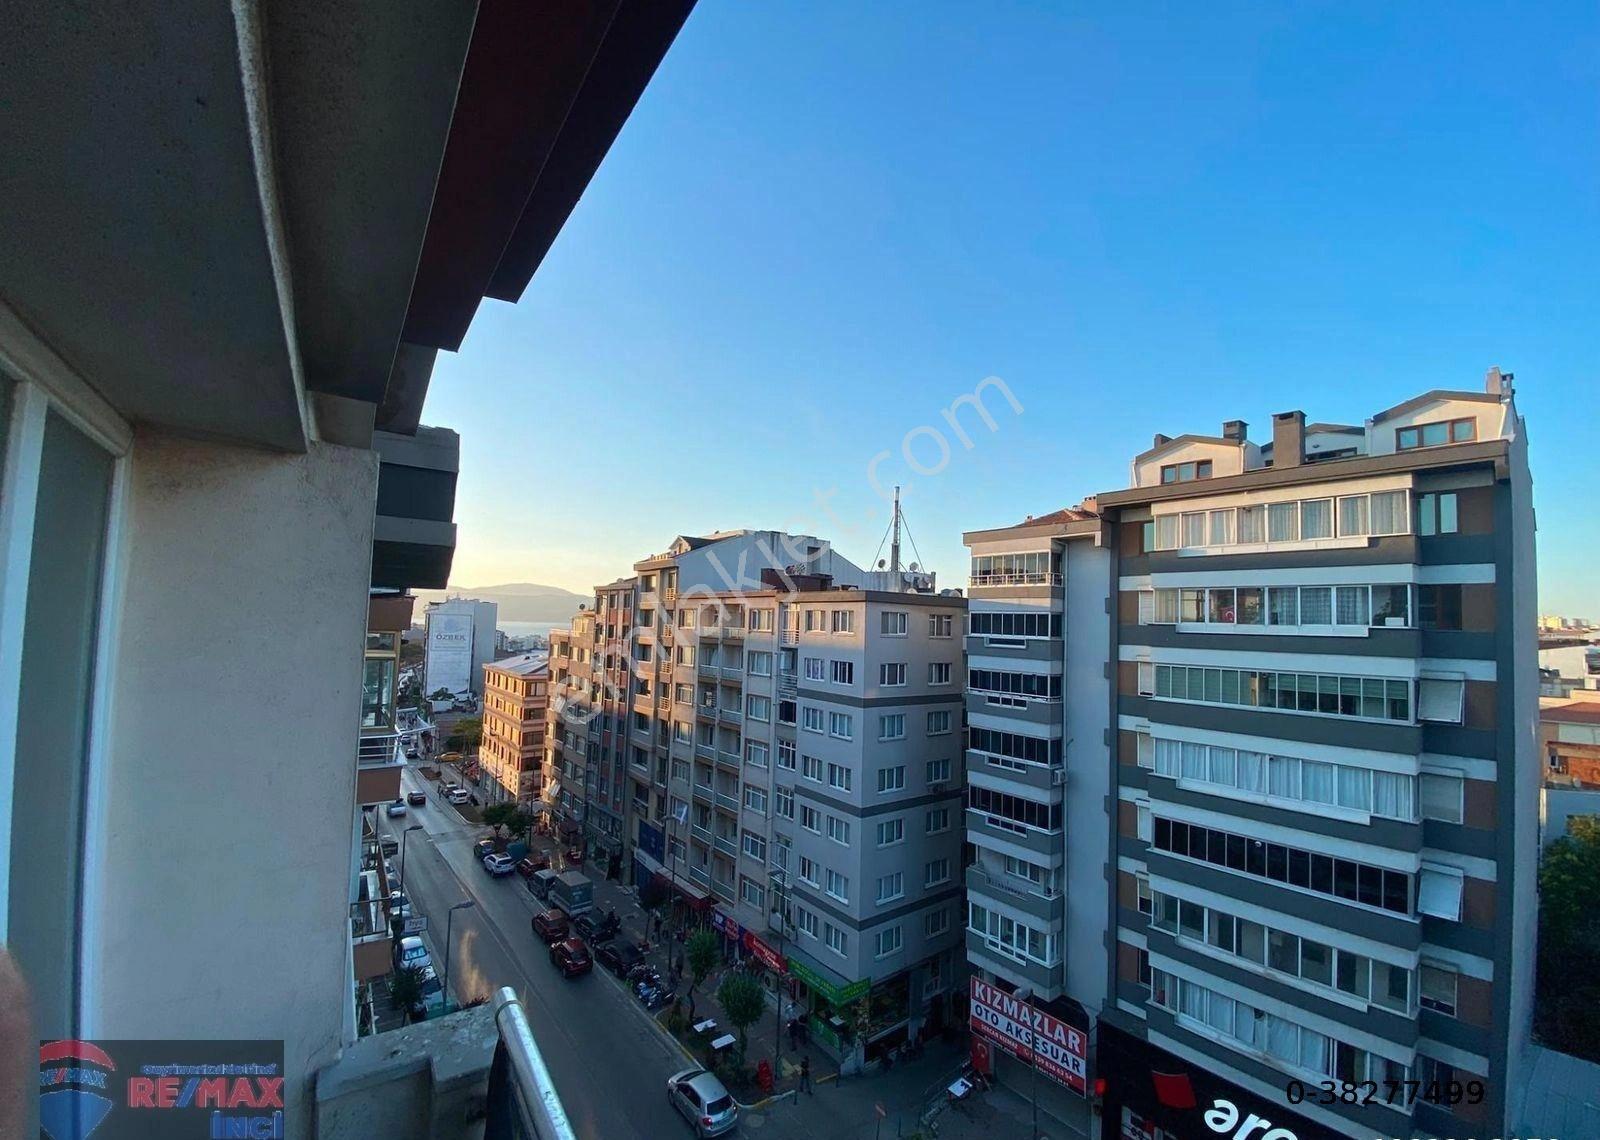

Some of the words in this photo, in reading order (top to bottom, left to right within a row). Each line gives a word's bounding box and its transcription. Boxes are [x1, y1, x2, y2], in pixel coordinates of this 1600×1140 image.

[974, 980, 1081, 1053] KIZMAZLAR
[975, 1004, 999, 1026] OTO
[1006, 1023, 1081, 1073] AKSESUAR
